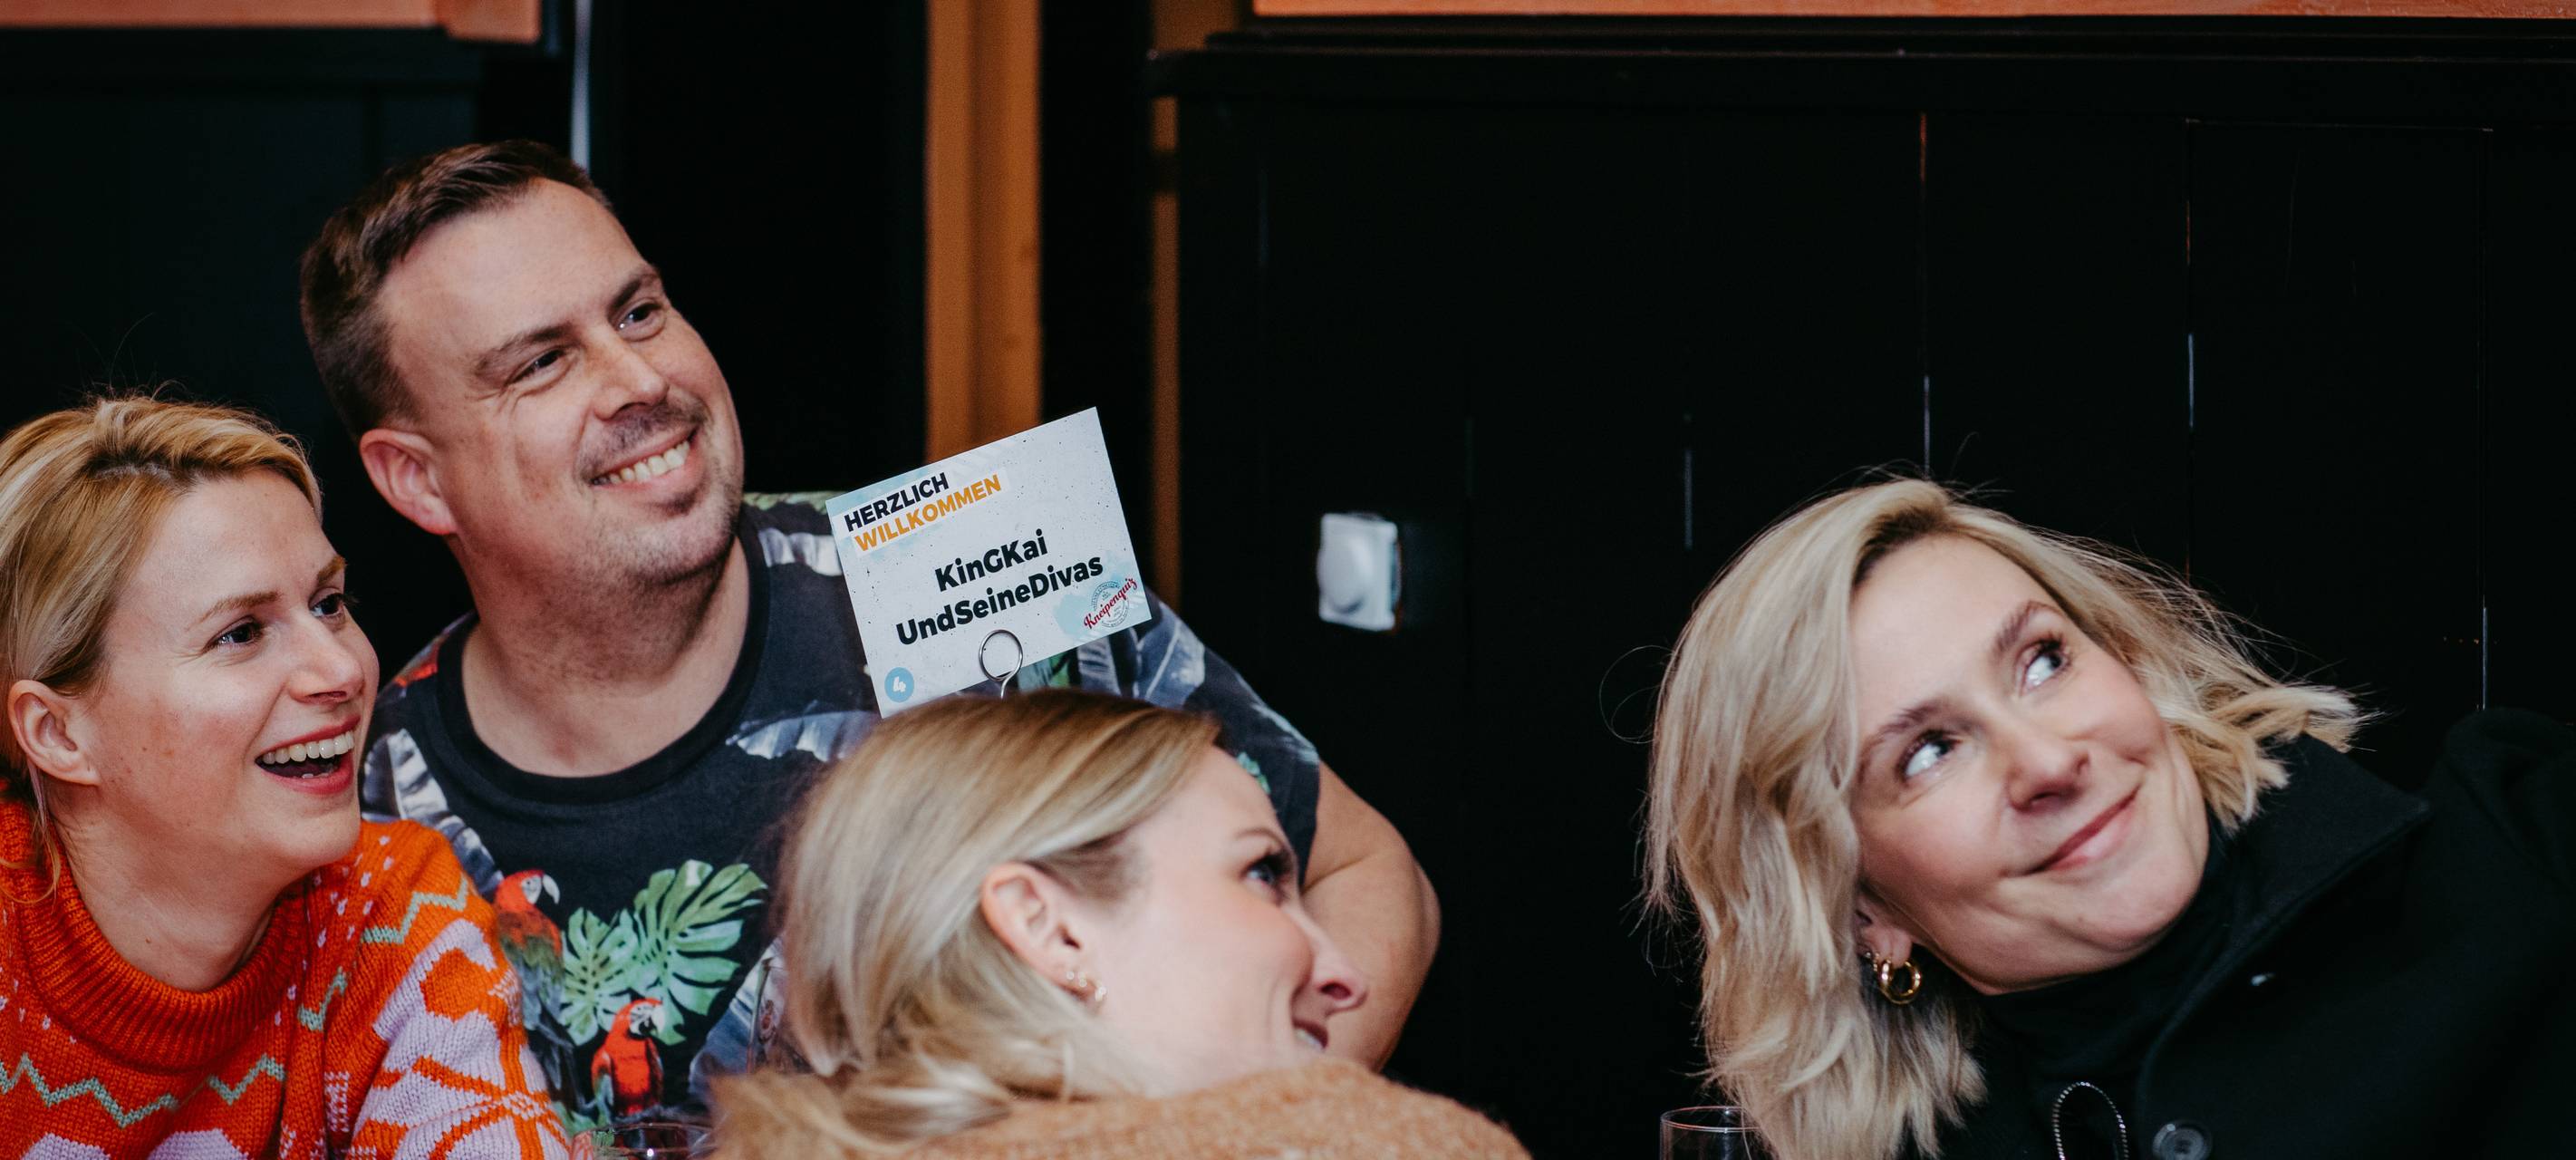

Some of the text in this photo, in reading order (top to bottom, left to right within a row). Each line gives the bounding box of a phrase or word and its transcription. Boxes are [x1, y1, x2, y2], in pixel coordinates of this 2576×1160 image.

[844, 472, 949, 532] HERZLICH
[854, 474, 1001, 551] WILLKOMMEN
[935, 528, 1047, 592] KinGKai
[896, 556, 1103, 645] UndSeineDivas
[1084, 578, 1137, 629] Kneipenquiz
